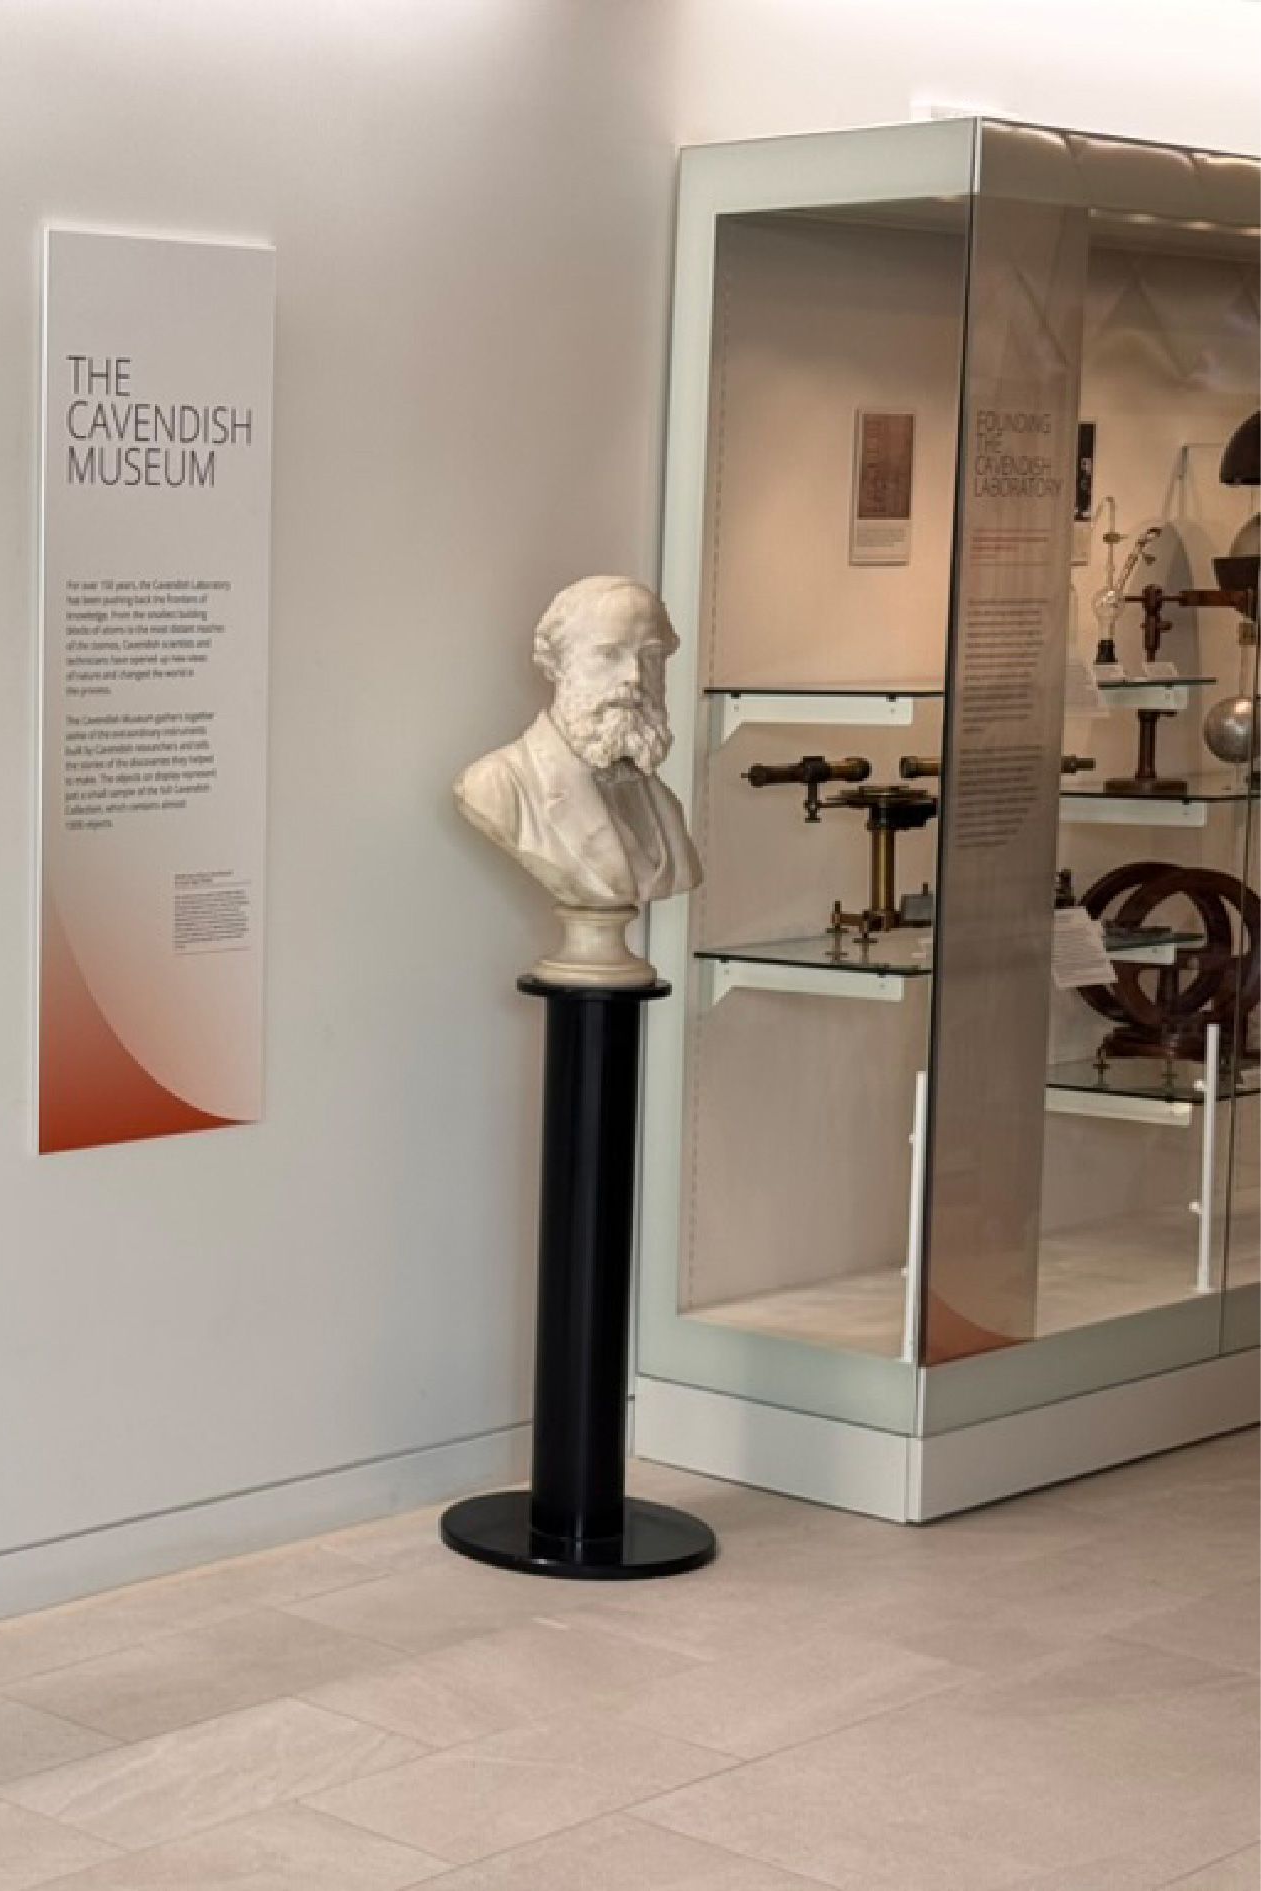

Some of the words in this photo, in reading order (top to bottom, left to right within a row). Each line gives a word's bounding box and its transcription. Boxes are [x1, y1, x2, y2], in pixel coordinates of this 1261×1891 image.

[66, 355, 131, 396] THE
[67, 400, 252, 445] CAVENDISH
[68, 445, 215, 488] MUSEUM
